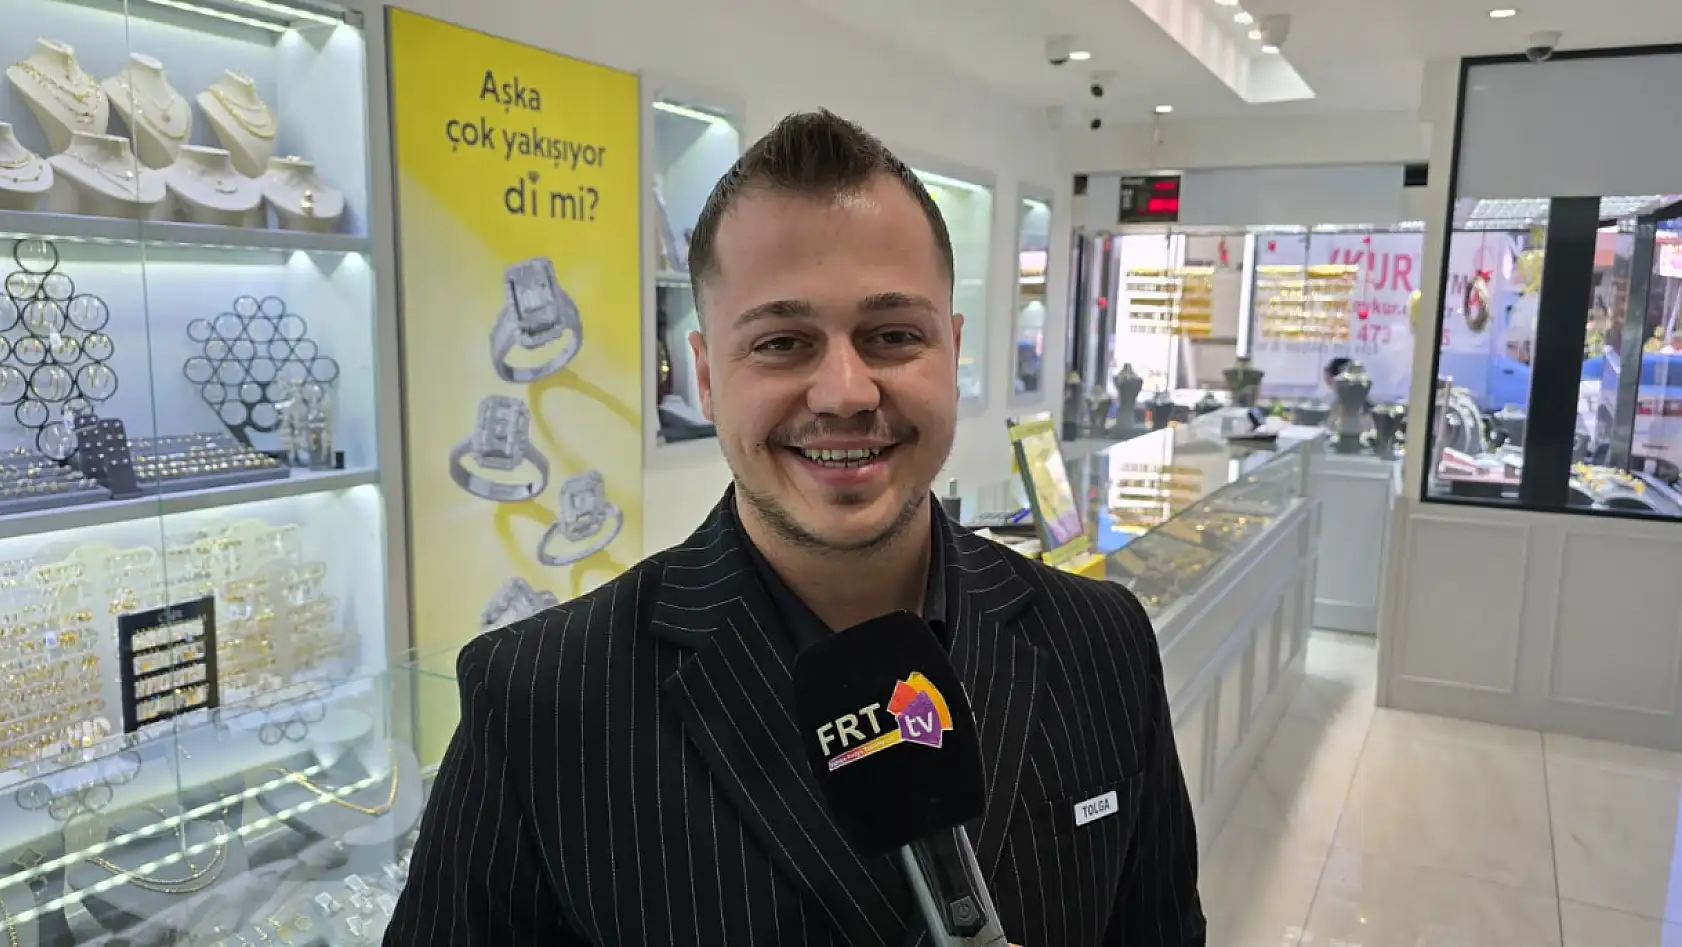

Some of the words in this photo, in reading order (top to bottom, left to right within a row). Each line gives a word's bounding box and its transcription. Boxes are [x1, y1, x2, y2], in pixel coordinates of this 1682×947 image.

[480, 69, 542, 113] Aşka
[445, 116, 496, 154] çok
[502, 127, 606, 171] yakışıyor
[504, 171, 538, 217] di
[550, 185, 600, 222] mi?
[816, 702, 881, 757] FRT
[904, 711, 934, 738] tv
[1082, 798, 1110, 818] TOLGA
